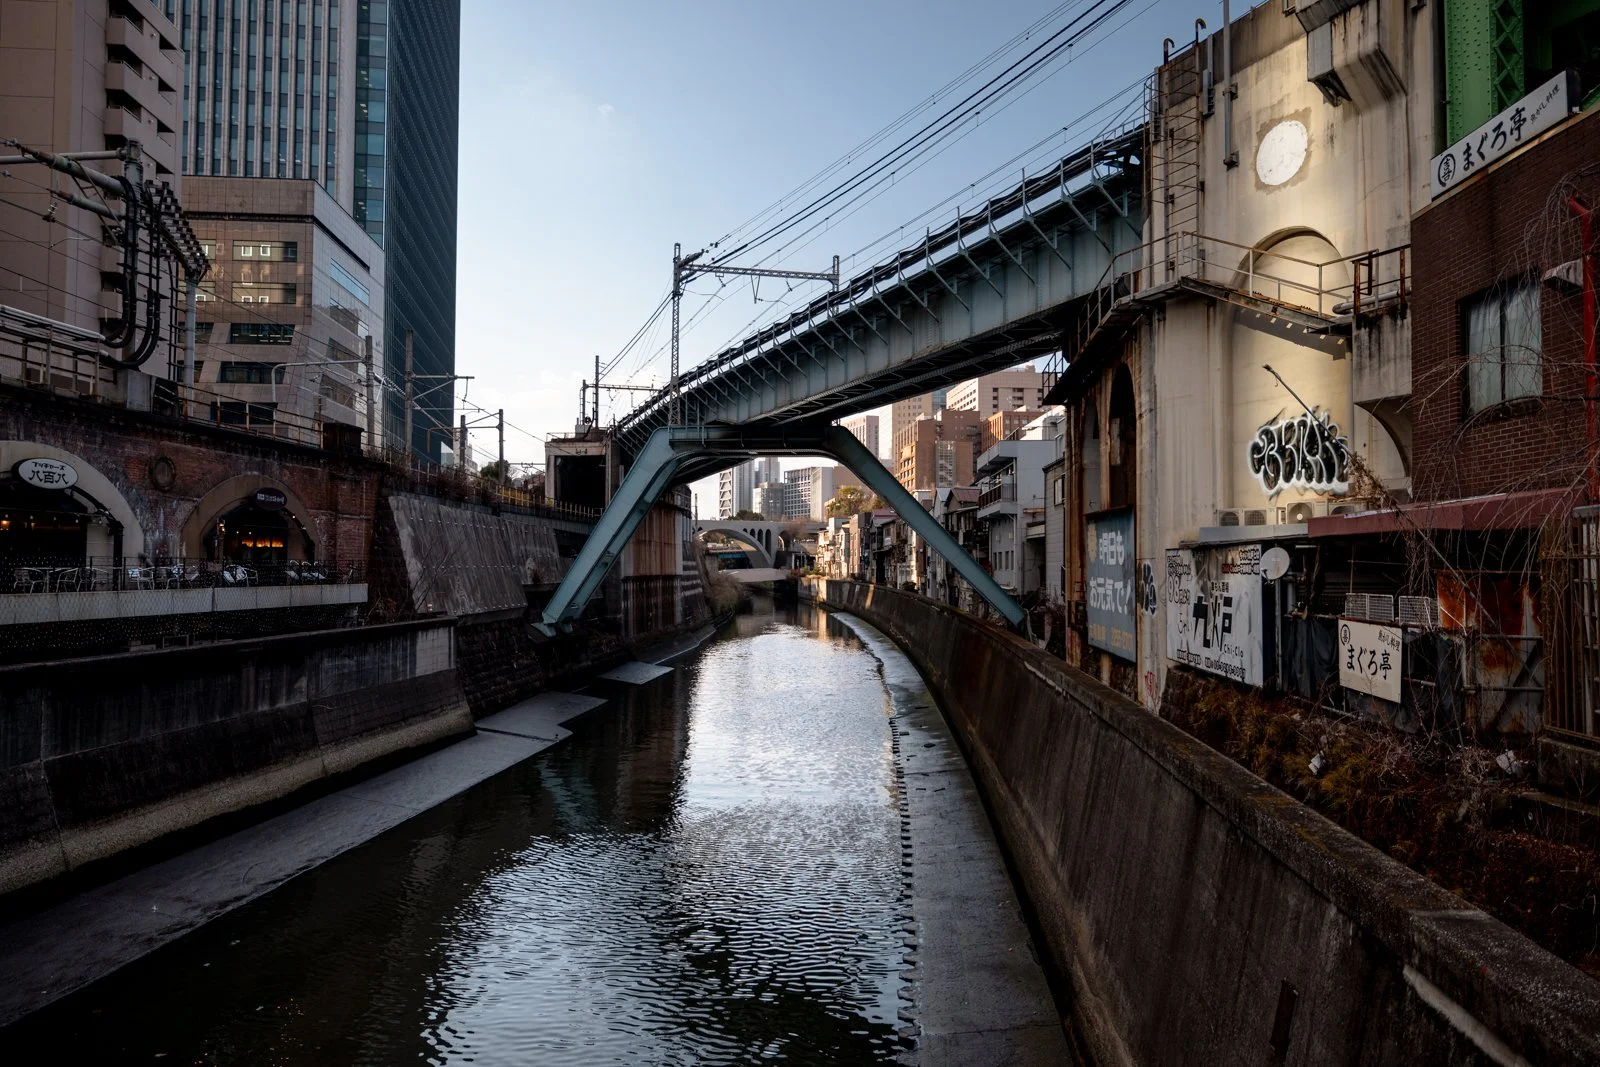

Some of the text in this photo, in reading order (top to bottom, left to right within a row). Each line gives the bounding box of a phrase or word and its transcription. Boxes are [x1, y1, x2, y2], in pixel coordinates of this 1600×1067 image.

[1462, 106, 1527, 172] まぐろ亭
[28, 470, 69, 485] 八百八
[1099, 530, 1125, 566] 明日も
[1346, 644, 1392, 680] まぐろ亭
